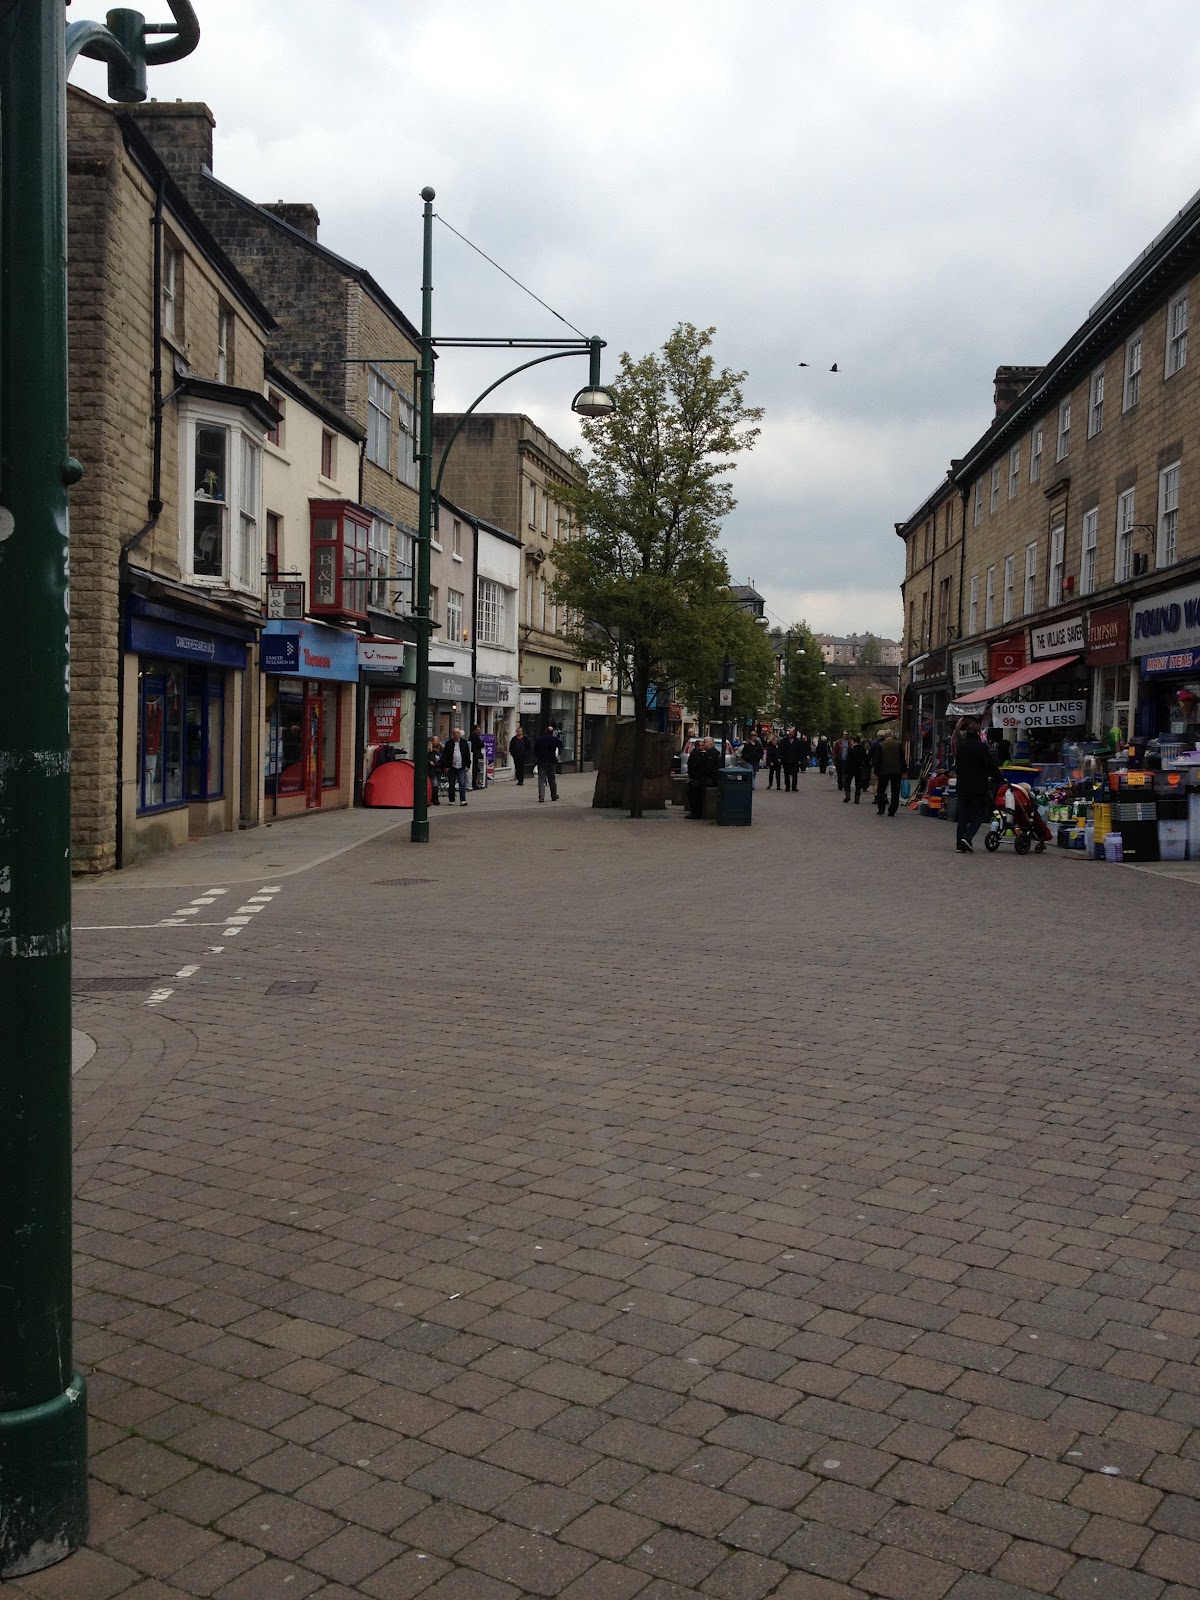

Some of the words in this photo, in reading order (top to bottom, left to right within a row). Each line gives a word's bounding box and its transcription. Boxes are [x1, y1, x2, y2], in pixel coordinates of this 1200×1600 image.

[1134, 603, 1181, 640] POUND
[1037, 635, 1046, 650] THE
[1046, 629, 1066, 648] VILLAGE
[1090, 621, 1119, 642] TIMPSON
[304, 648, 331, 669] Thomson
[376, 653, 398, 661] Thomson
[1146, 655, 1169, 672] MANY
[1169, 652, 1193, 670] ITEMS
[373, 707, 397, 717] DOWN
[1029, 703, 1046, 713] OF
[1050, 701, 1083, 712] LINES
[376, 717, 394, 727] SALE
[1024, 716, 1042, 726] OR
[1046, 715, 1076, 725] LESS
